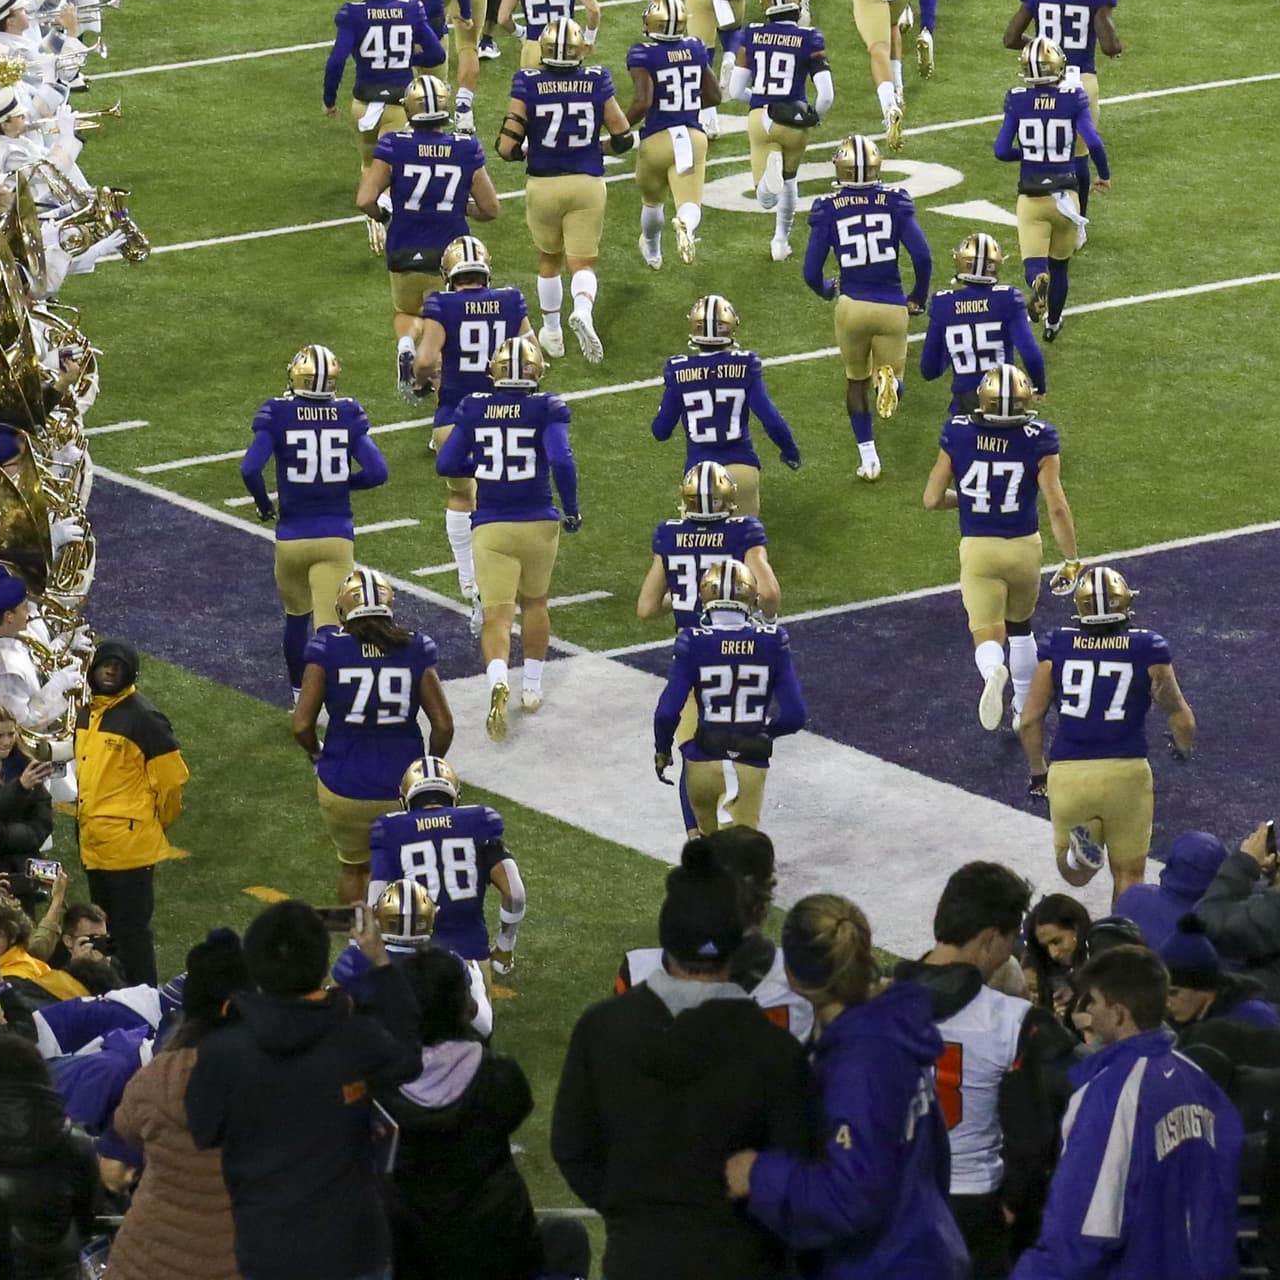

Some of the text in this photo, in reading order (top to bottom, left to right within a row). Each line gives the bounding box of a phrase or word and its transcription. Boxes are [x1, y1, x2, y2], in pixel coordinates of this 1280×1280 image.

[367, 8, 403, 21] FROELICH
[1038, 3, 1091, 49] 83
[359, 25, 413, 69] 49
[668, 48, 692, 62] DUMAS
[752, 32, 803, 49] McCUTCHEON
[537, 80, 593, 95] ROSENGARTEN
[657, 65, 703, 112] 32
[751, 51, 797, 96] 19
[1033, 97, 1056, 111] RYAN
[535, 101, 595, 148] 73
[1018, 118, 1073, 163] 90
[418, 144, 452, 158] BUELOW
[403, 164, 462, 211] 77
[833, 195, 869, 210] HOPKINS
[837, 213, 896, 268] 52
[465, 299, 500, 316] FRAZIER
[955, 299, 989, 314] SHROCK
[458, 321, 507, 373] 91
[945, 322, 1005, 374] 85
[675, 363, 747, 382] TOOMEY-STOUT
[296, 406, 338, 422] COUTTS
[483, 403, 521, 420] JUMPER
[682, 388, 746, 443] 27
[286, 428, 349, 484] 36
[474, 426, 537, 481] 35
[976, 434, 1008, 454] HARTY
[959, 461, 1025, 513] 47
[676, 532, 724, 548] WESTOVER
[721, 640, 754, 655] GREEN
[1073, 635, 1130, 650] McGANNON
[338, 668, 414, 723] 79
[699, 664, 770, 723] 22
[1059, 659, 1134, 721] 97
[416, 815, 452, 832] MOORE
[400, 837, 479, 902] 88
[836, 1125, 853, 1149] 4
